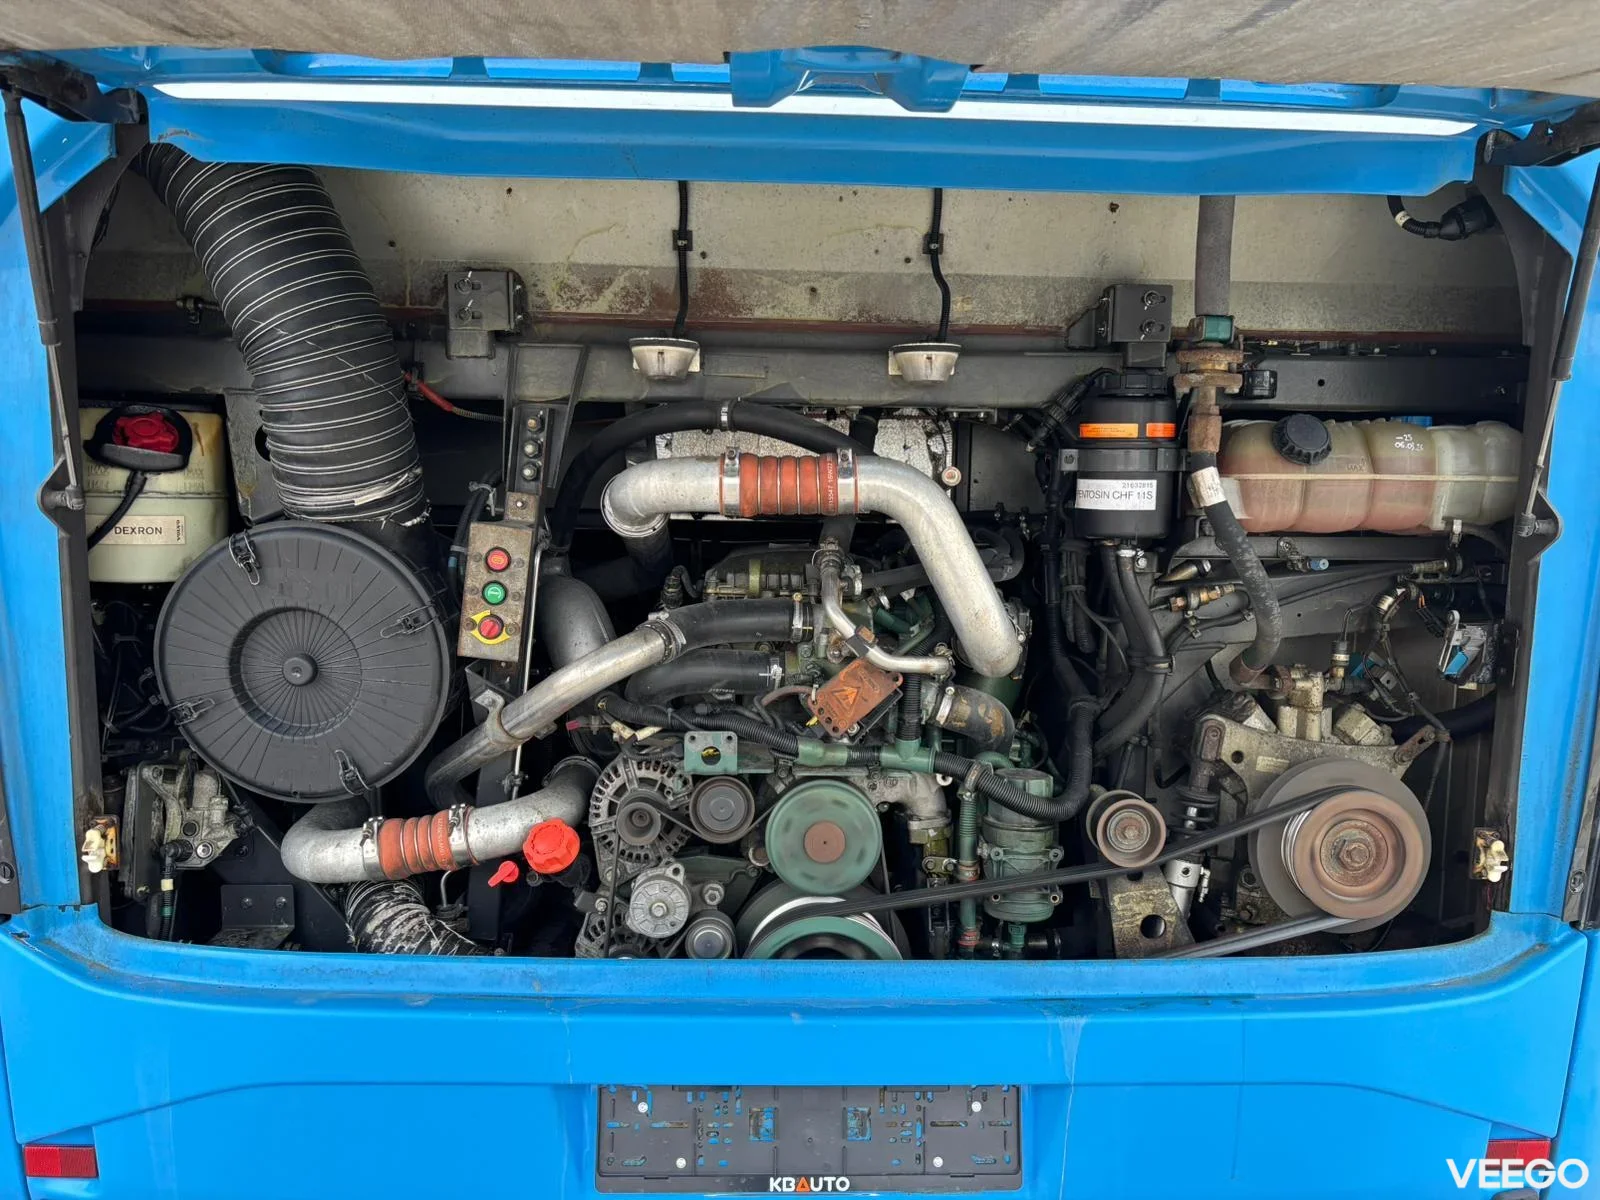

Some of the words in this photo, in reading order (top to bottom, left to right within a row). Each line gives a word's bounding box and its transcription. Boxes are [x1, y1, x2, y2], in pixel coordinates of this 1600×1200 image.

[1112, 490, 1134, 500] CHF
[1137, 490, 1154, 500] 11S
[114, 526, 163, 535] DEXRON
[769, 1176, 850, 1192] KBAUTO
